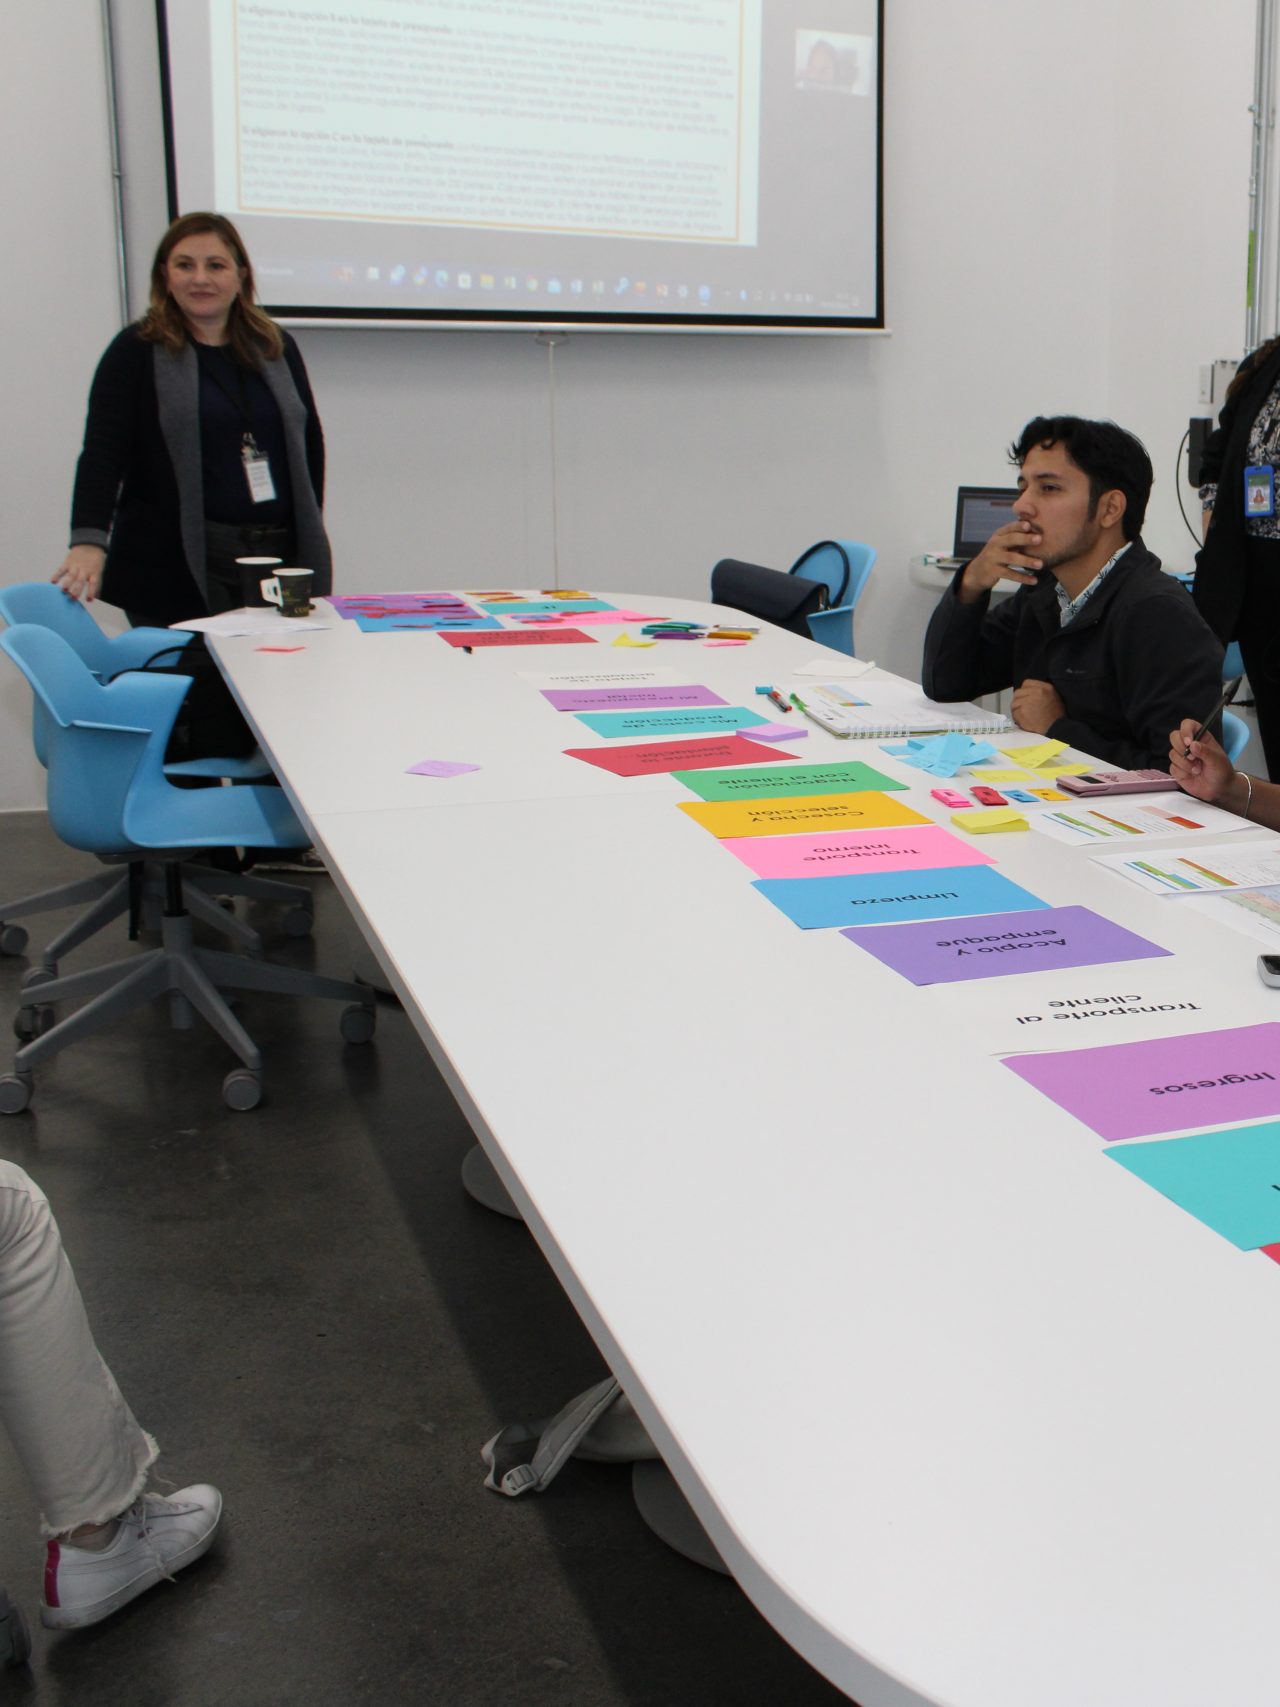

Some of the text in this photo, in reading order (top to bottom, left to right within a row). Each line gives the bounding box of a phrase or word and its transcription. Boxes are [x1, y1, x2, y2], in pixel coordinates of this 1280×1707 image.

[623, 714, 724, 724] producción
[718, 776, 784, 785] cliente
[727, 777, 857, 790] Negociación
[748, 805, 849, 816] selección
[769, 810, 865, 822] Cosecha
[803, 848, 921, 862] Transporte
[813, 843, 892, 853] interno
[850, 890, 960, 906] Limpieza
[935, 929, 1058, 947] empaque
[956, 938, 1067, 956] Acopio y
[1048, 994, 1142, 1009] cliente
[1015, 1001, 1202, 1025] Transporte al
[1149, 1071, 1276, 1096] Ingresos
